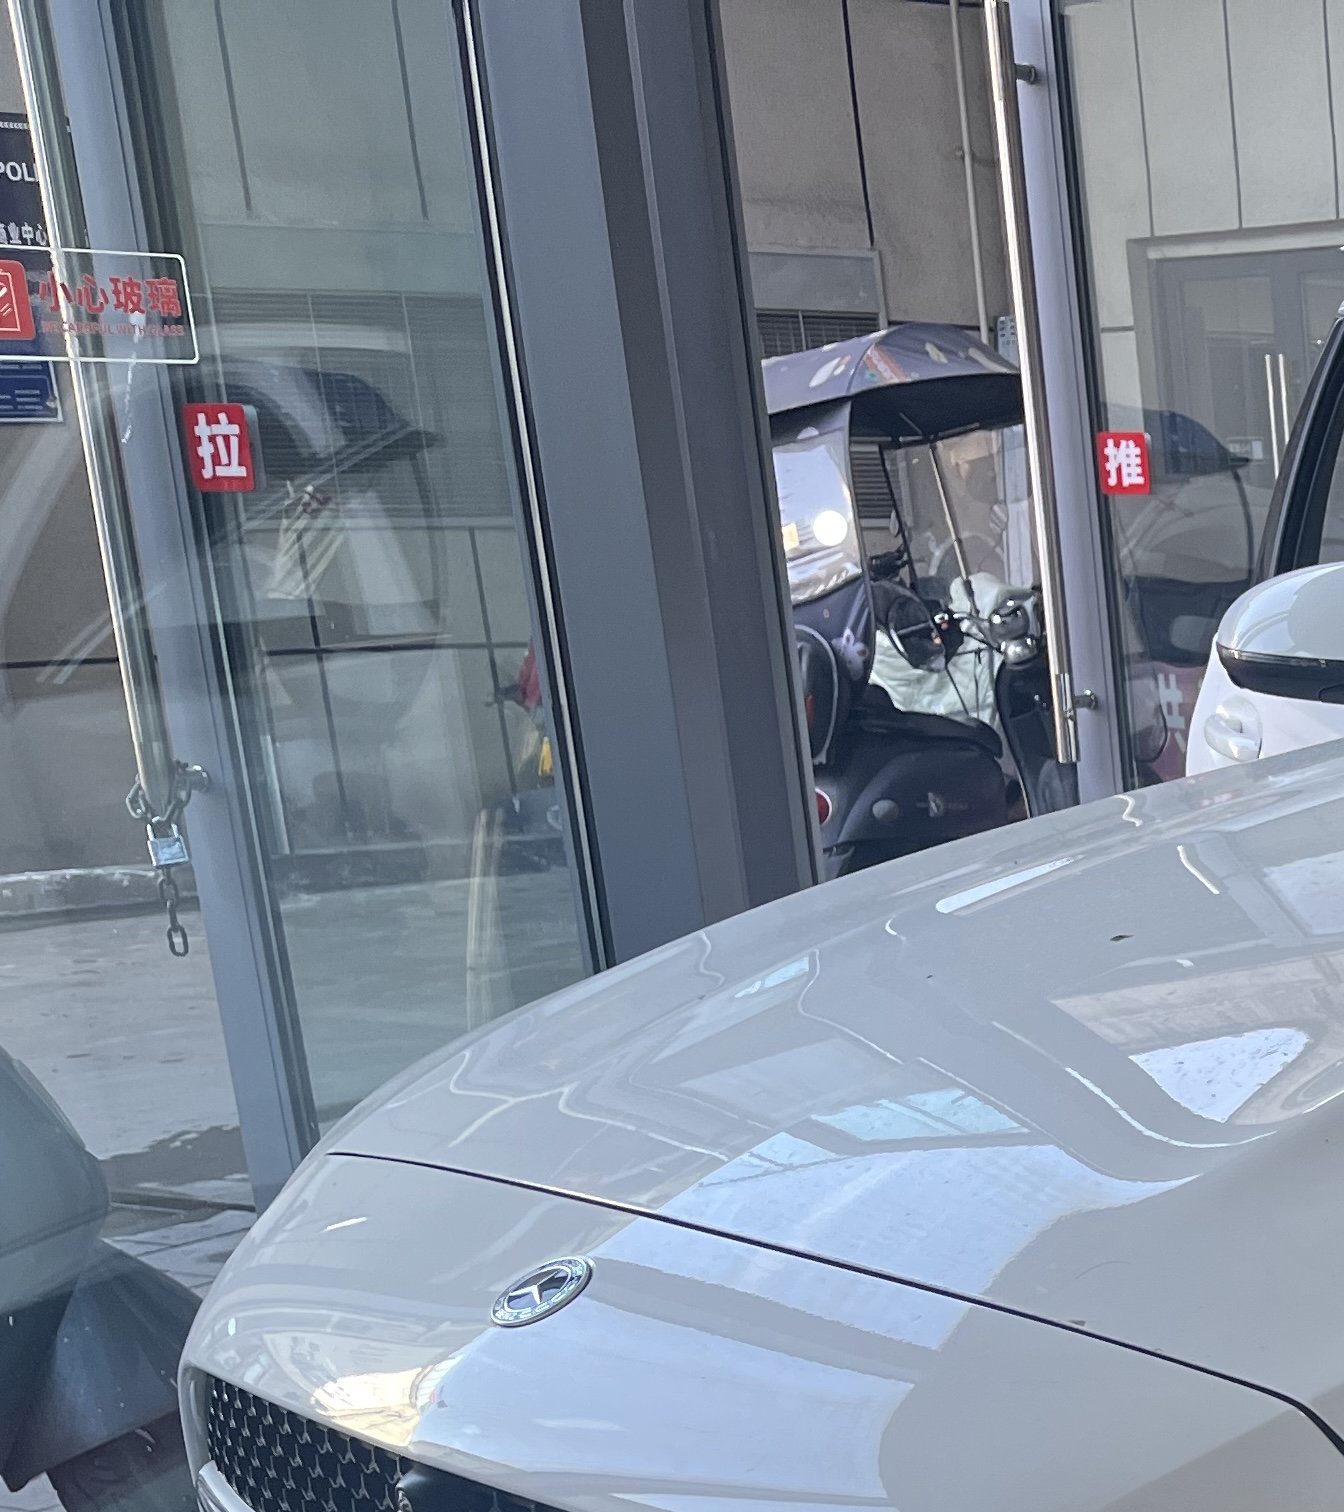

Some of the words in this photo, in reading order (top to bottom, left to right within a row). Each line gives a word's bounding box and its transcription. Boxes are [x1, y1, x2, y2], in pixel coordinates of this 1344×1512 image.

[39, 271, 182, 318] 小心玻璃
[193, 411, 247, 479] 拉
[1104, 437, 1145, 488] 推
